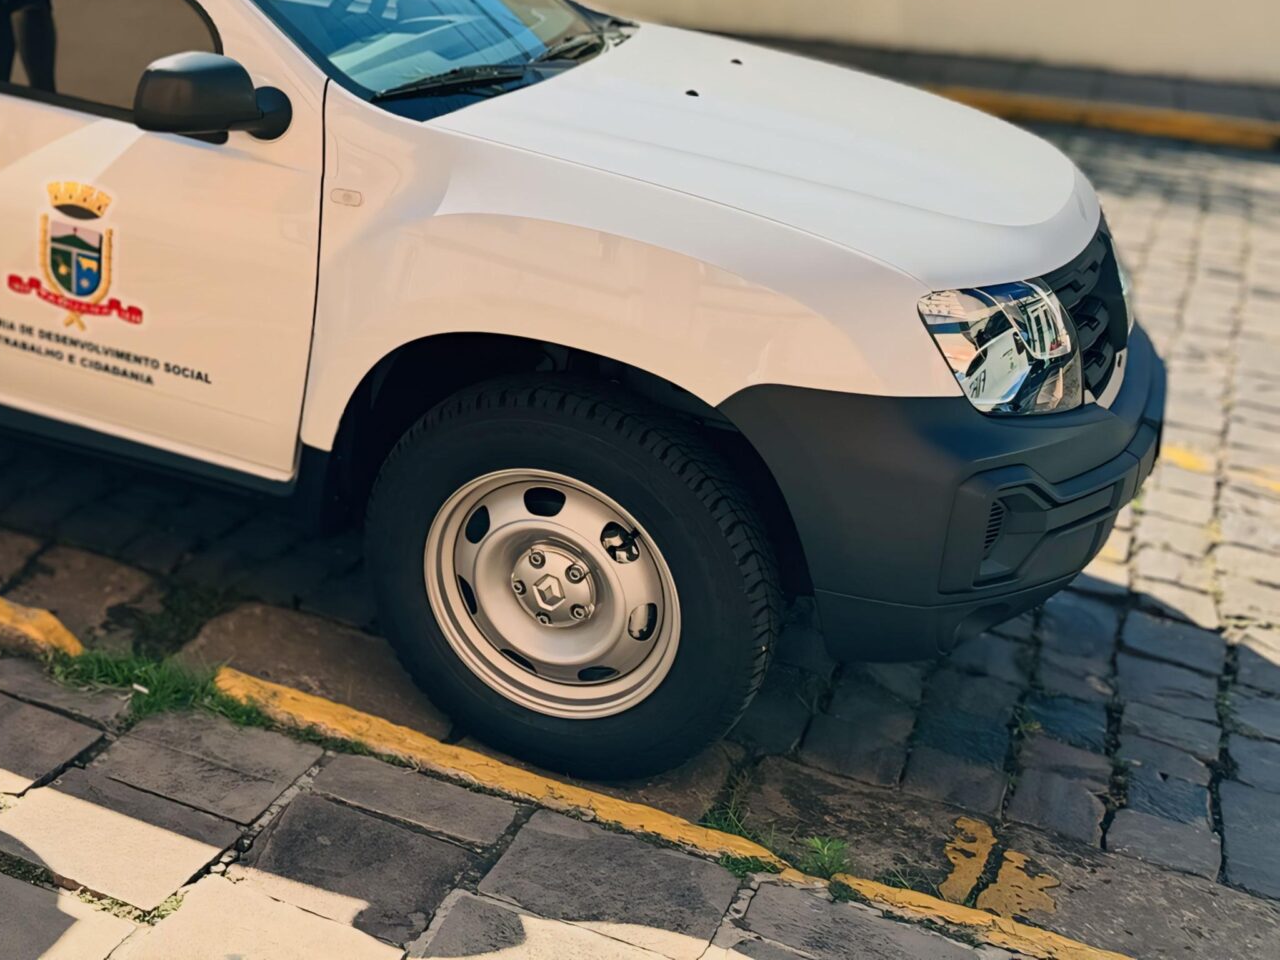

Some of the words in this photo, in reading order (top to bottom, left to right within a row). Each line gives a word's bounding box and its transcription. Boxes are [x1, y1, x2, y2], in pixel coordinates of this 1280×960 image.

[19, 323, 35, 337] DE
[38, 328, 160, 370] DESENVOLVIMENTO
[163, 361, 211, 385] SOCIAL
[66, 352, 76, 365] E
[79, 357, 154, 386] CIDADANIA
